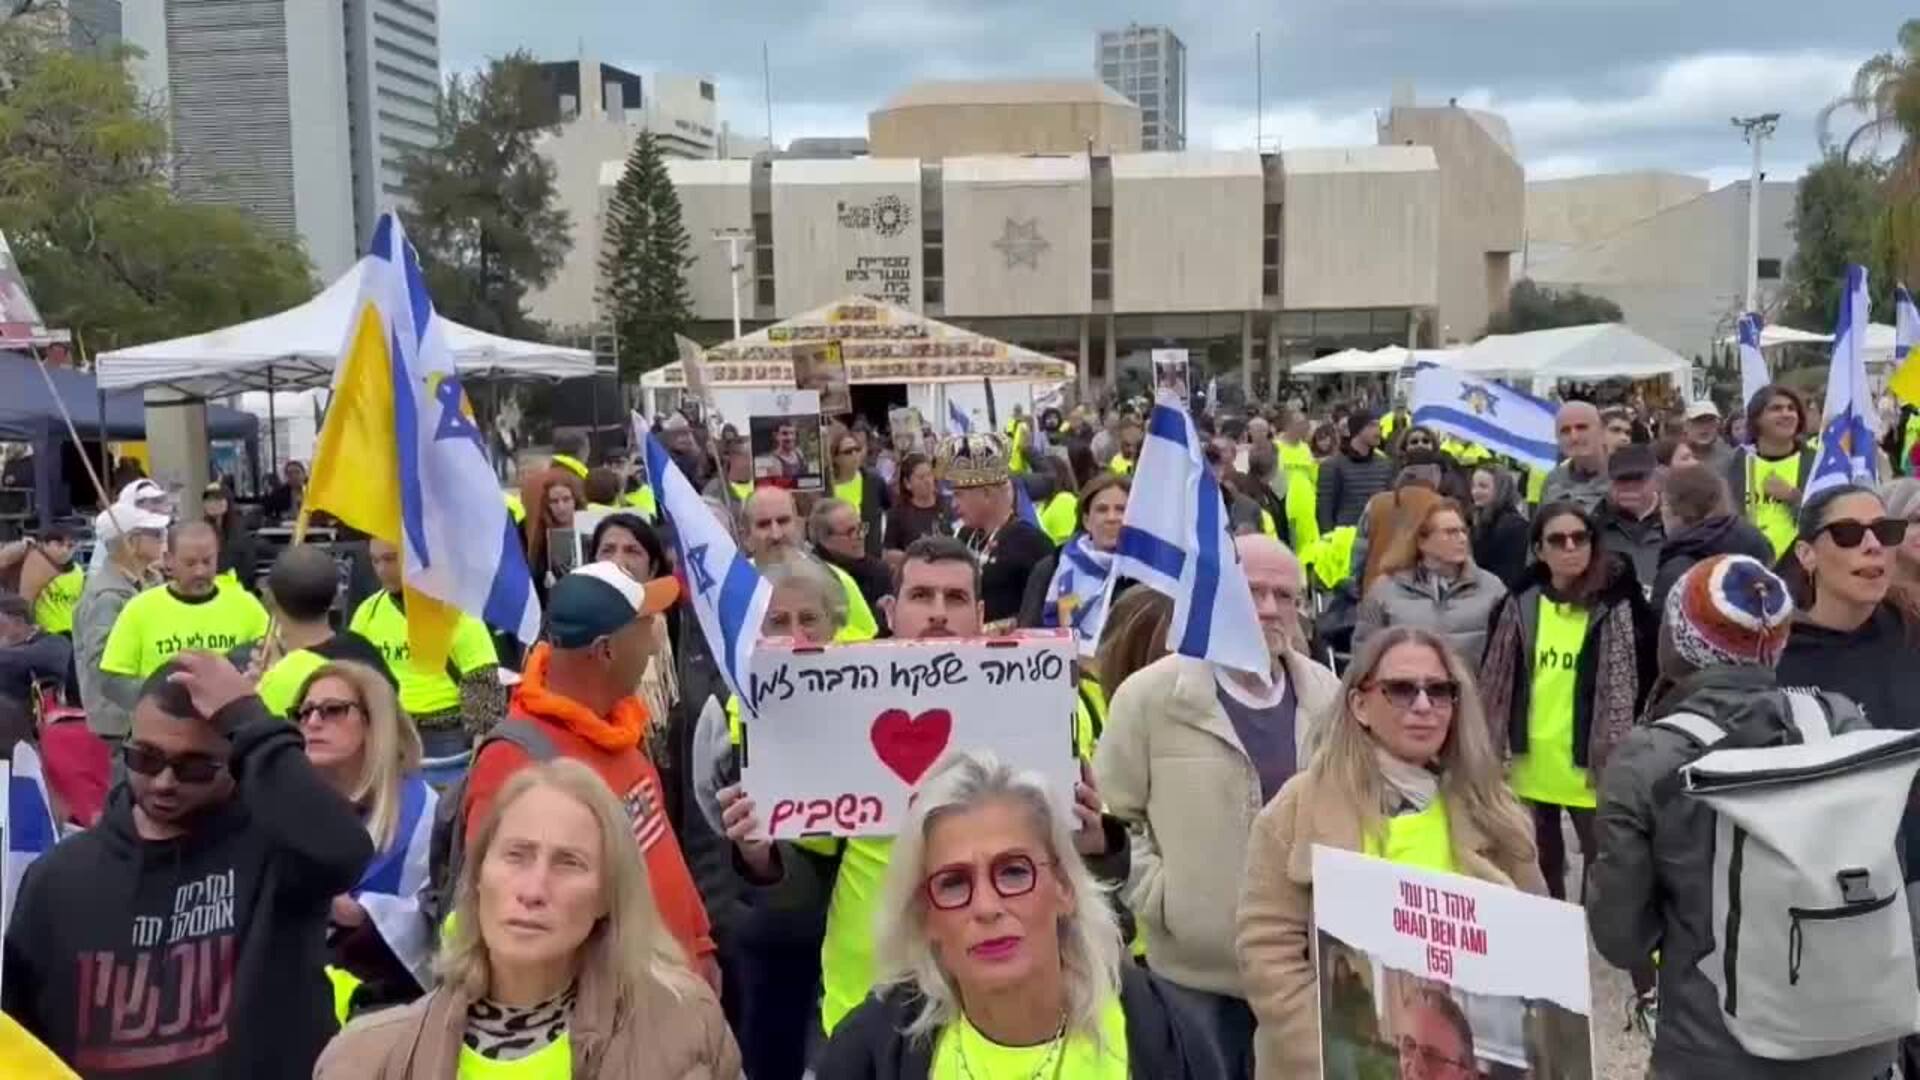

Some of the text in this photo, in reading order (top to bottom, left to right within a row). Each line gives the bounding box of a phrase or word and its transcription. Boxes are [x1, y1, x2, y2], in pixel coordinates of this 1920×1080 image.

[883, 281, 911, 293] בית
[156, 632, 237, 655] אתם לא לבד
[1539, 645, 1558, 670] לא
[798, 663, 879, 693] הרבה
[979, 648, 1063, 686] סליחה
[749, 662, 795, 711] זמן
[768, 792, 883, 836] השבים
[1399, 880, 1476, 923] אוהד בן עמי
[1393, 907, 1488, 956] OHAD BEN AMI
[1426, 943, 1453, 979] (55)
[77, 935, 236, 1042] עכשיו
